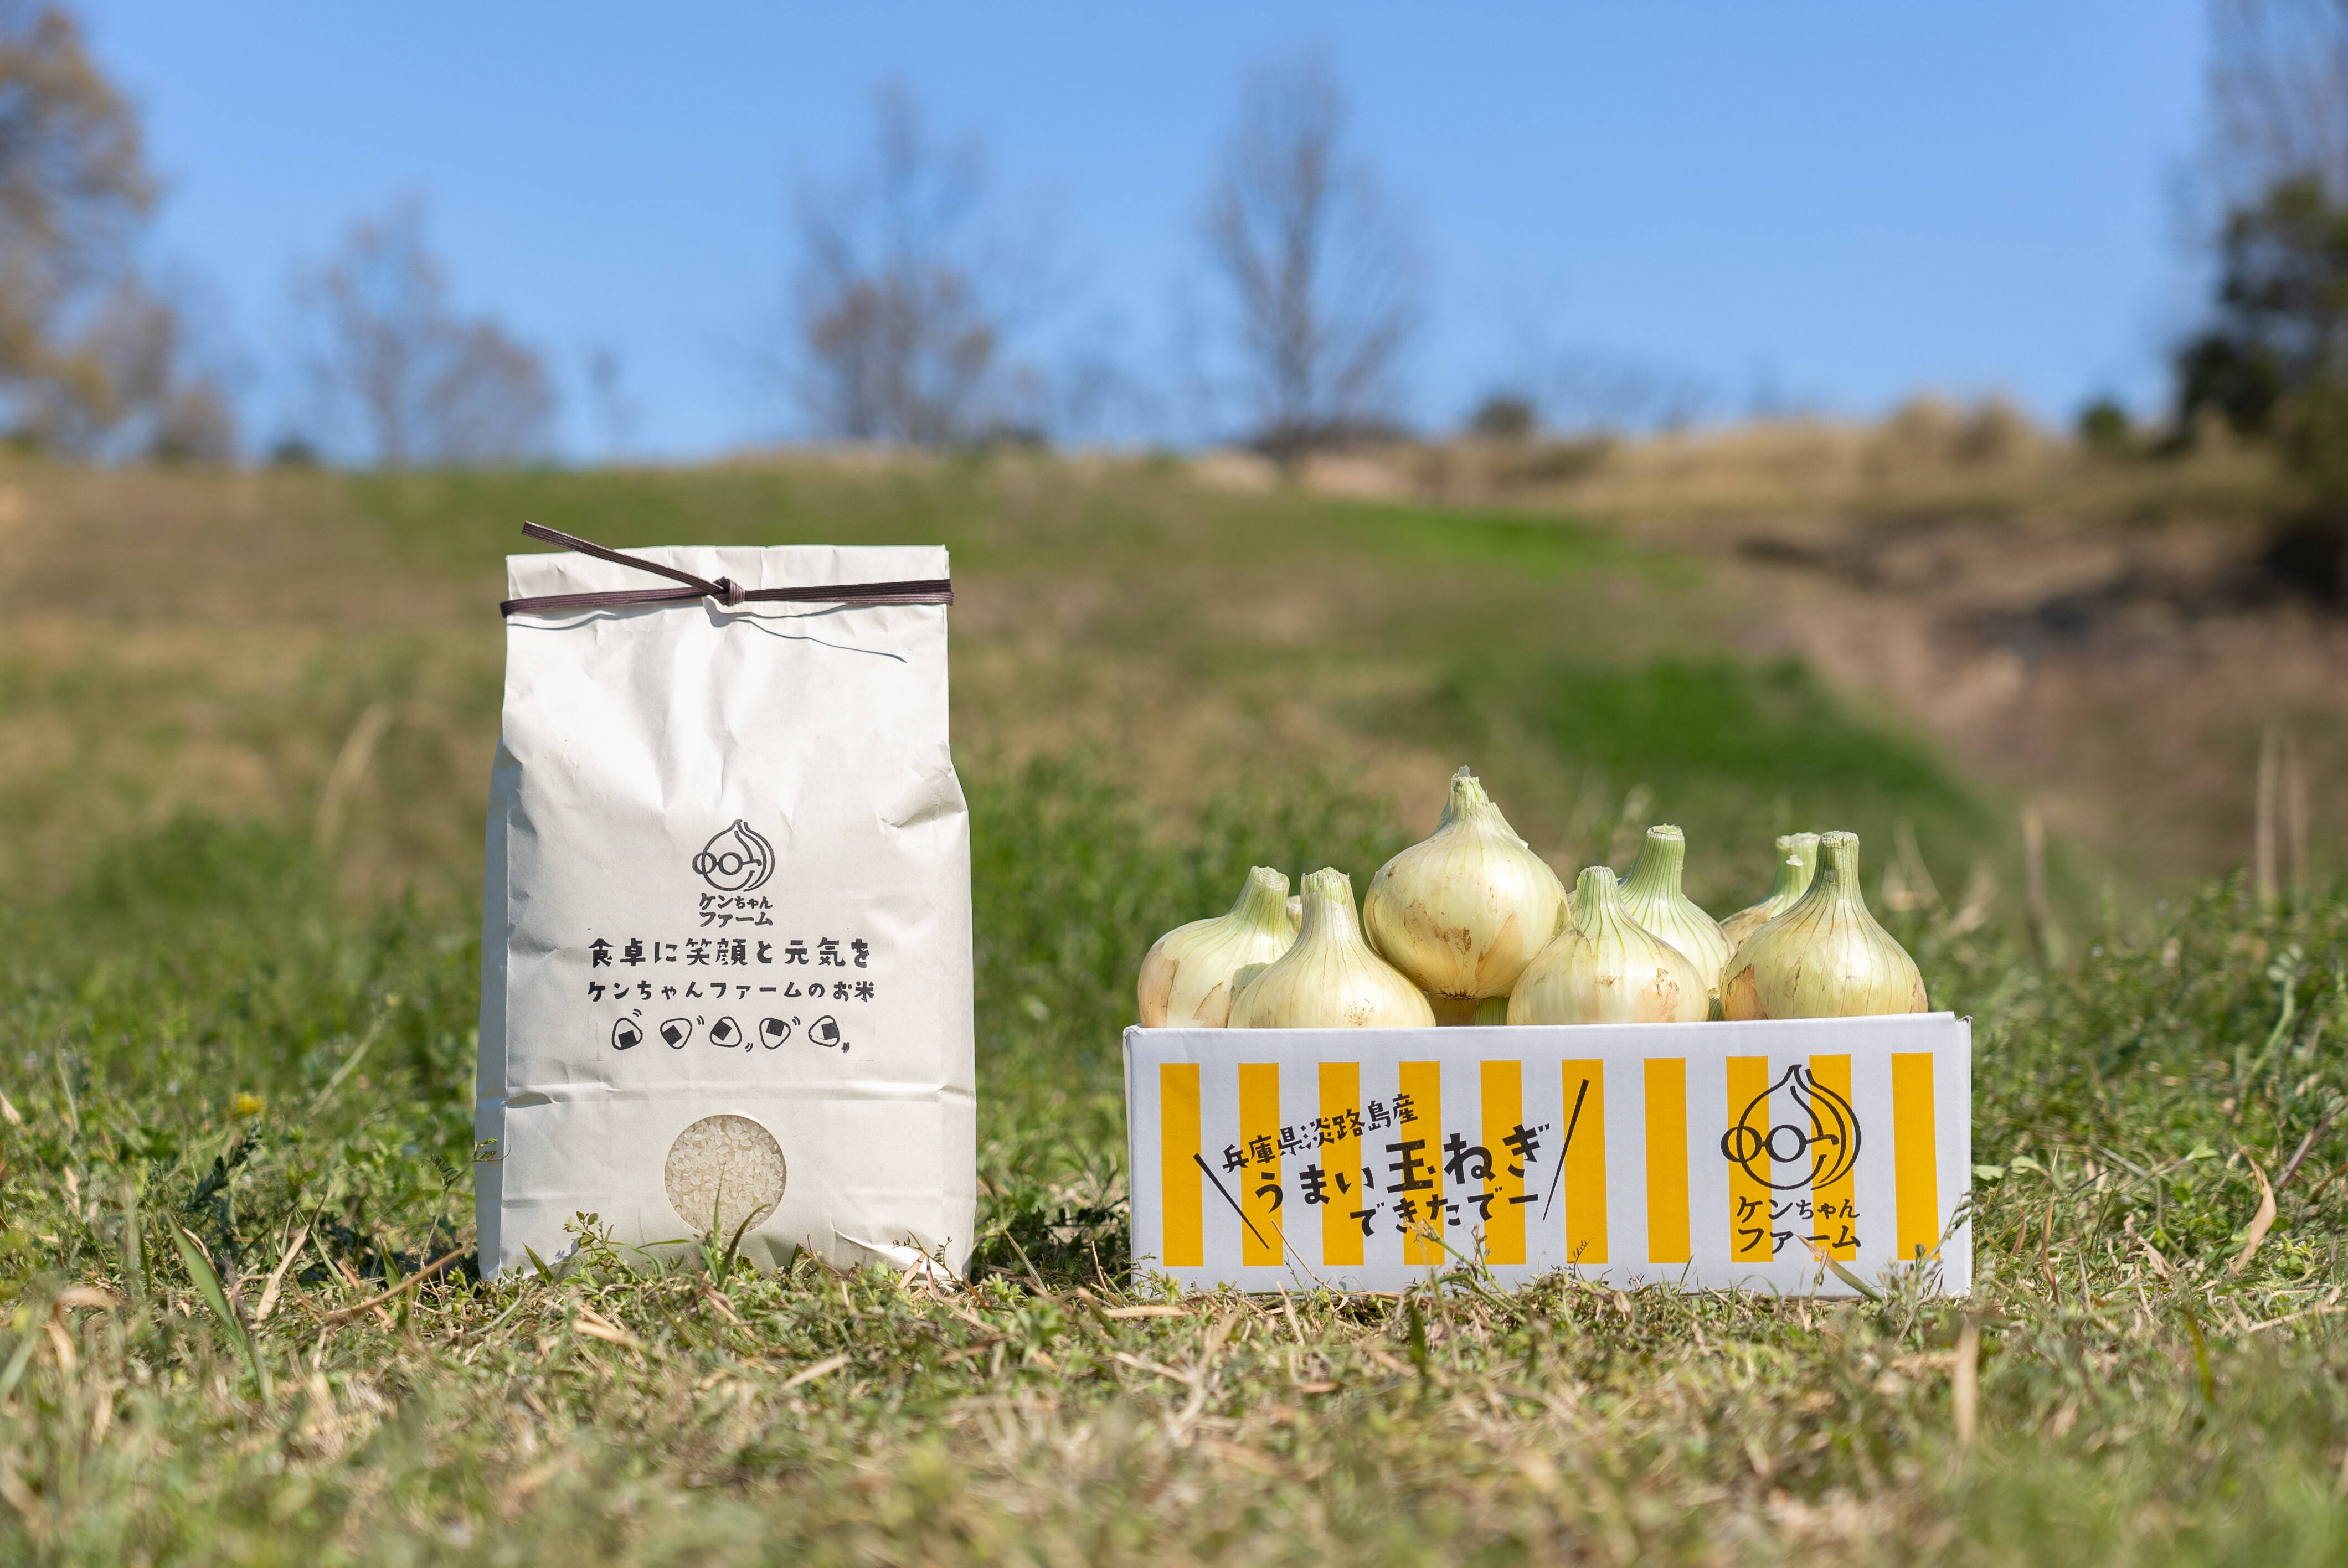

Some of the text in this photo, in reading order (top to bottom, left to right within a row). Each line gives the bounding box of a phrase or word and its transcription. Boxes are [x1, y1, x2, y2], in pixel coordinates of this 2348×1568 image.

[699, 893, 773, 910] ケンちゃん
[699, 911, 774, 927] ファーム
[588, 937, 870, 968] 食卓に笑顔と元気を
[587, 979, 875, 1002] ケンちゃんファームのお米
[1222, 1093, 1419, 1174] 兵庫県淡路島産
[1255, 1122, 1551, 1214] うまい玉ねぎ
[1350, 1186, 1539, 1237] できたでー
[1737, 1196, 1860, 1223] ケンちゃん
[1738, 1225, 1861, 1254] ファーム
